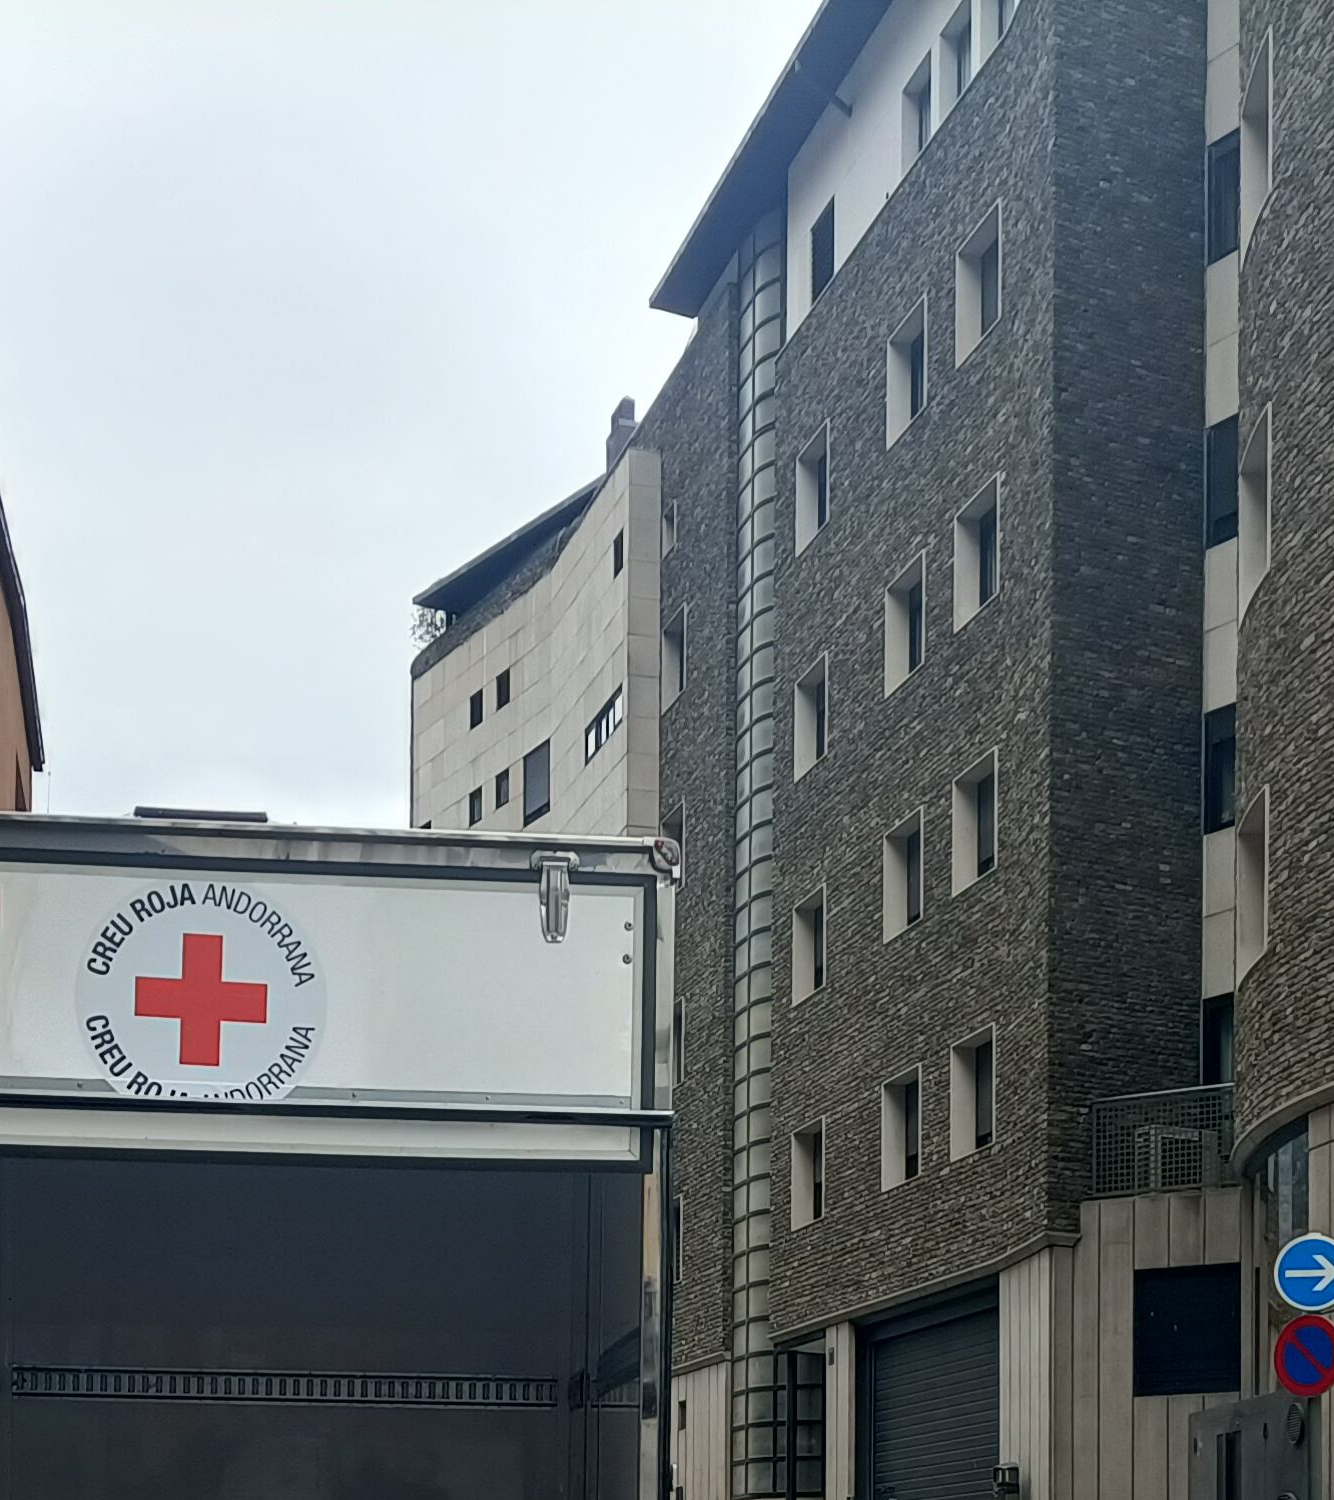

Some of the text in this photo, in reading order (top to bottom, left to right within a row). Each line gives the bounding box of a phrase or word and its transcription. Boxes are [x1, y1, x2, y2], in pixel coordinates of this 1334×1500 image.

[87, 883, 315, 987] CREU ROJA ANDORRANA
[86, 1015, 133, 1078] CREU
[126, 1071, 188, 1098] RO
